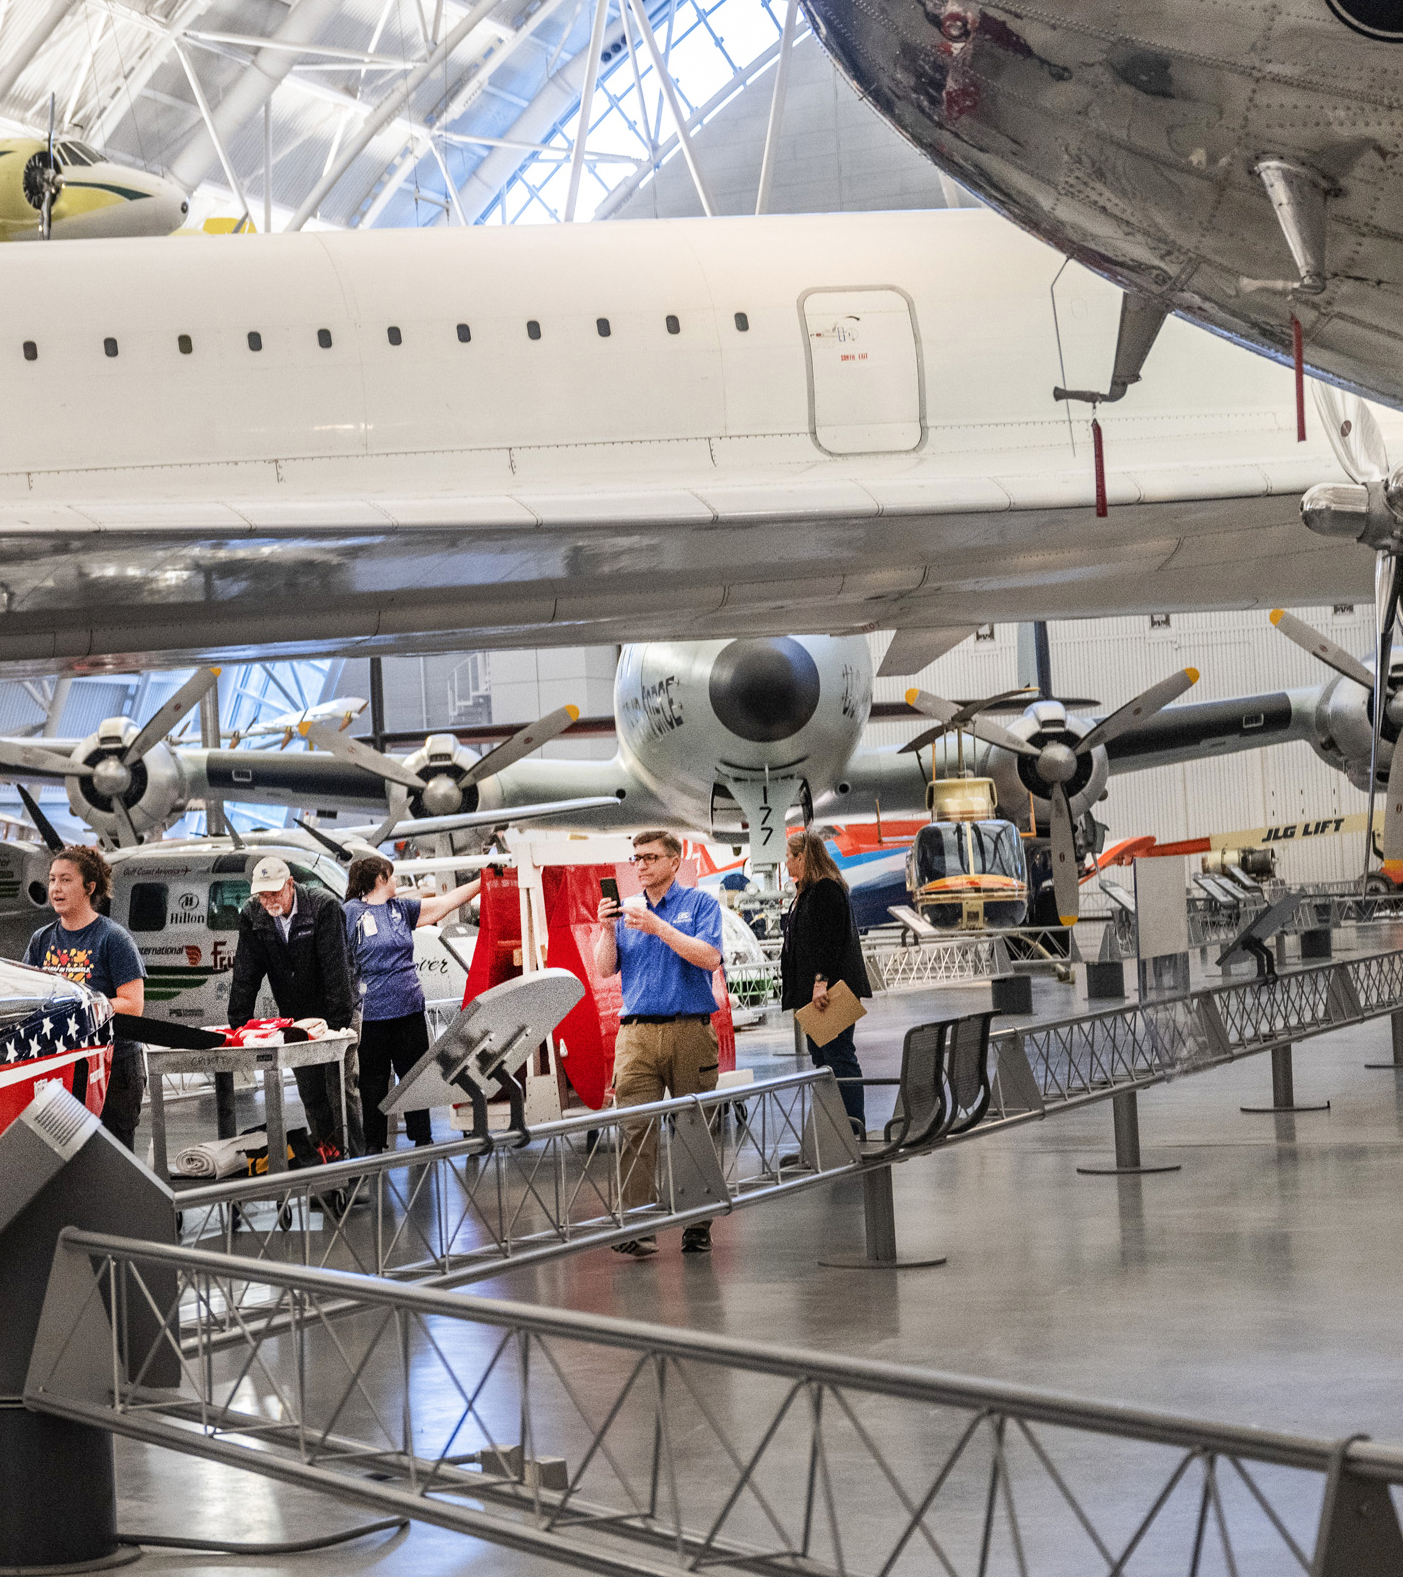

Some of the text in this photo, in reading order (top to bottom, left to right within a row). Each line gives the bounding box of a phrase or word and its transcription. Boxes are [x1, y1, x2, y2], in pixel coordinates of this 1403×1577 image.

[1261, 818, 1345, 843] JLG LIFT
[170, 912, 205, 925] Hilton
[139, 945, 184, 956] nternational
